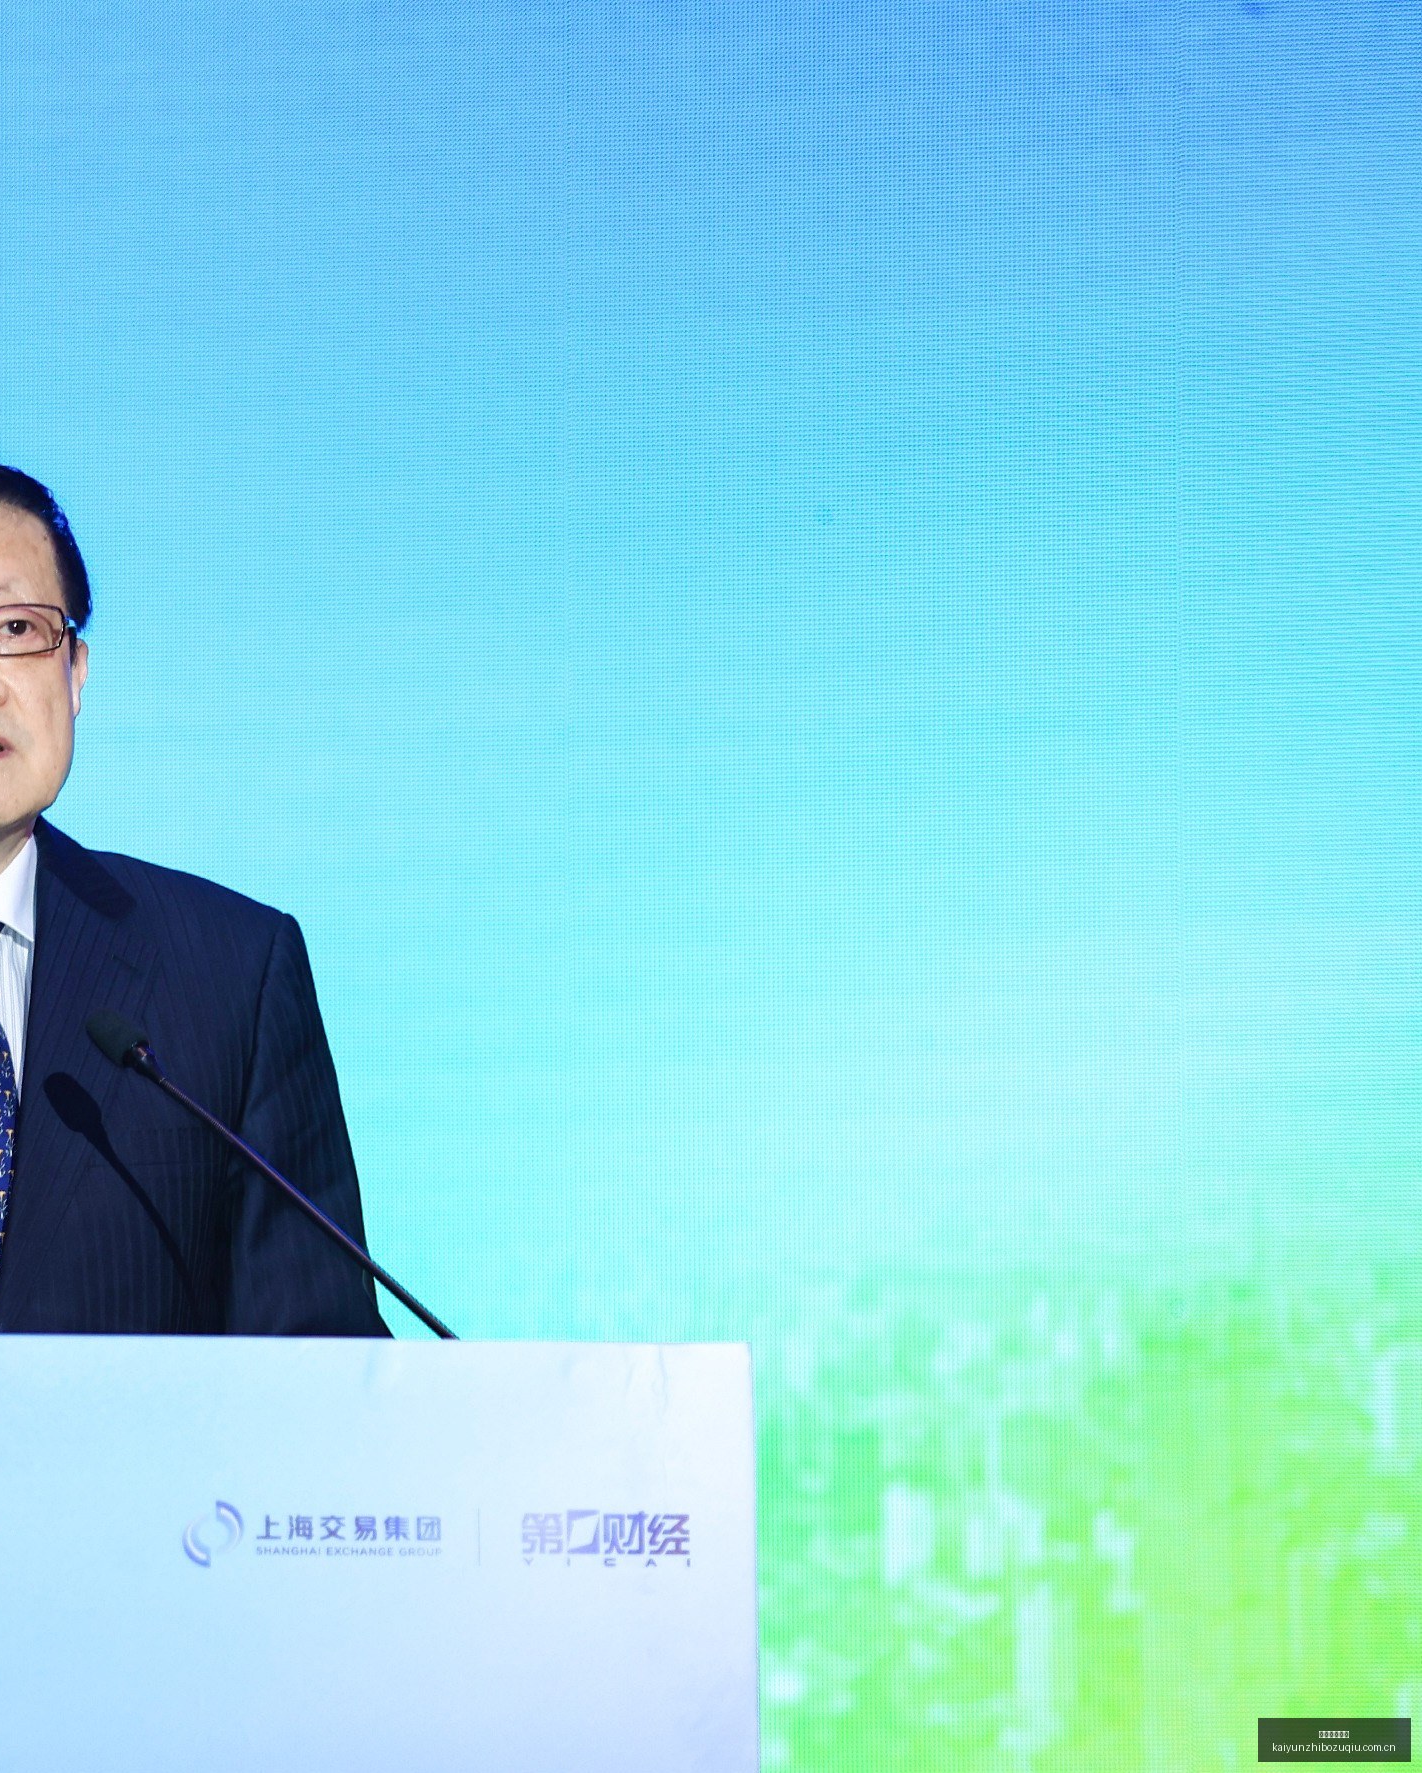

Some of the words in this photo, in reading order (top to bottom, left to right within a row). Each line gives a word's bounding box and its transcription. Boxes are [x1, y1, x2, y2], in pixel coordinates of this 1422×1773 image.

[256, 1514, 442, 1542] 上海交易集团
[256, 1546, 321, 1556] SHANGHAI
[326, 1546, 394, 1557] EXCHANGE
[399, 1547, 442, 1557] GROUP
